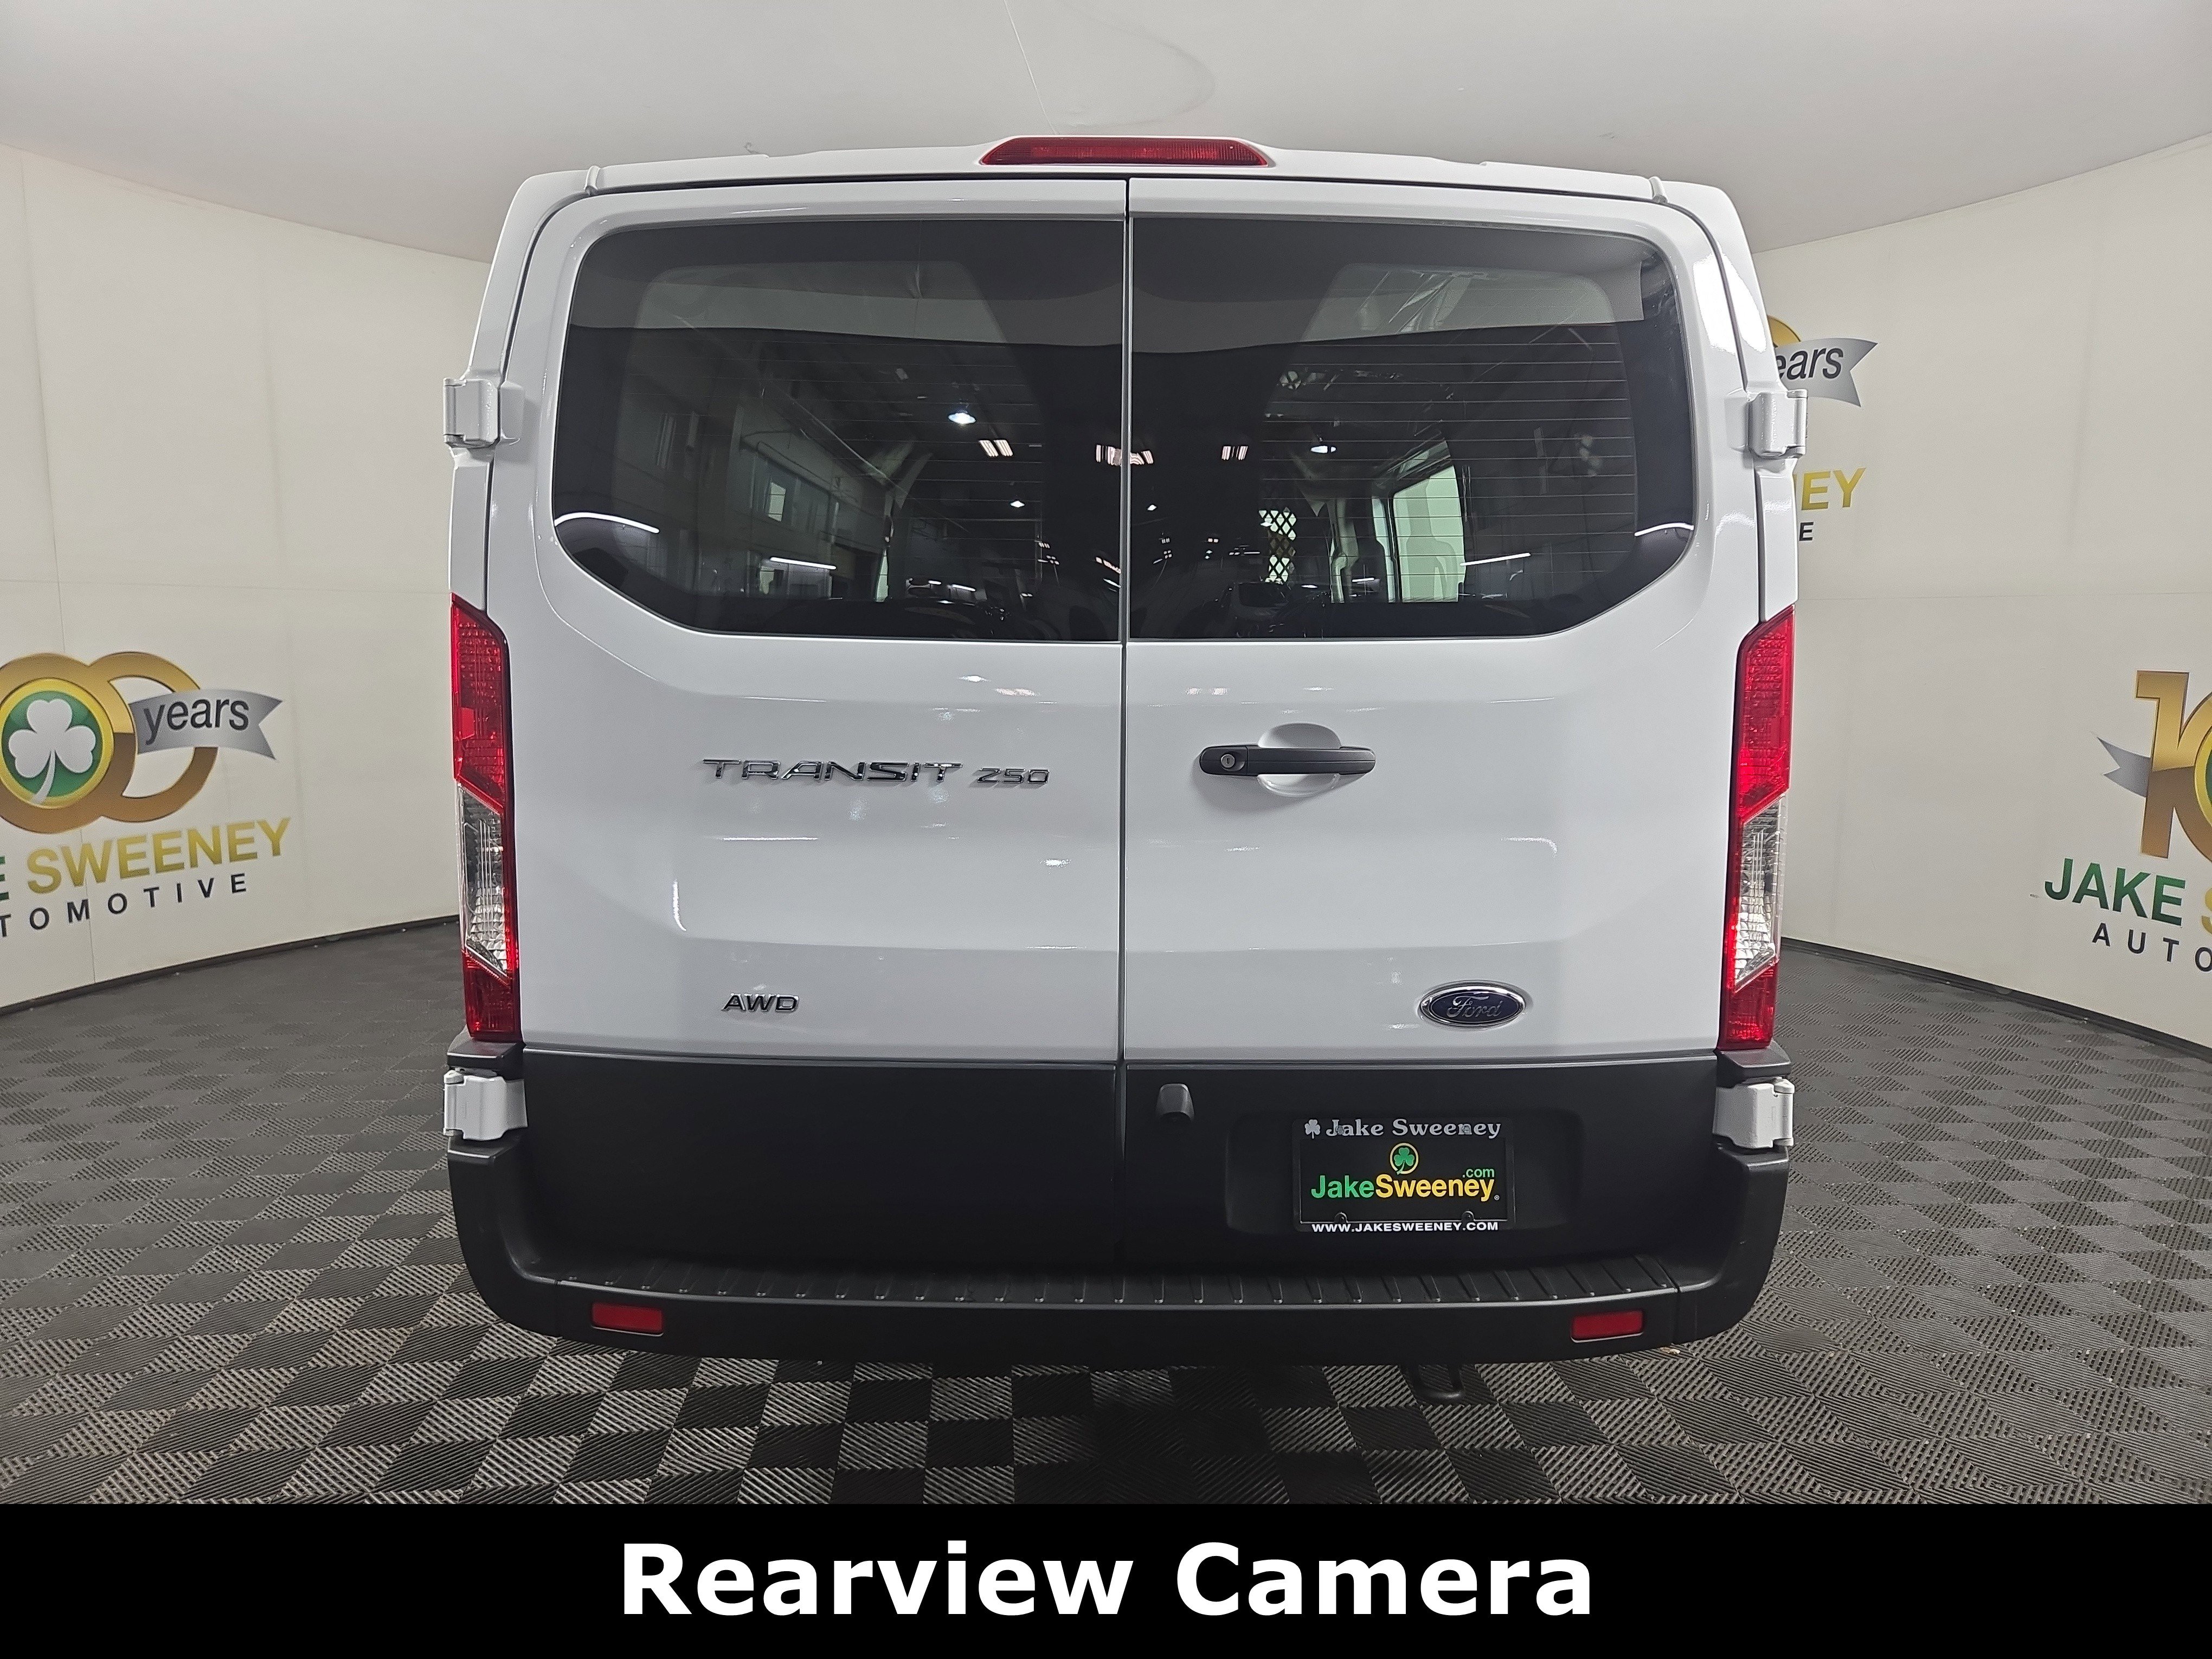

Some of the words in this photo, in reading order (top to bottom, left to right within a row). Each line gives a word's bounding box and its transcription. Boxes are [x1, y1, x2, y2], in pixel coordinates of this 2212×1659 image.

[1776, 348, 1843, 380] ears
[1793, 467, 1866, 511] EY
[143, 698, 250, 745] years
[703, 759, 963, 782] TRANSIT
[976, 767, 1050, 784] 250
[27, 818, 291, 895] SWEENEY
[2044, 857, 2186, 926] JAKE
[2092, 923, 2212, 972] AUTO
[721, 993, 799, 1012] AWD
[1446, 995, 1503, 1018] Ford
[1326, 1118, 1384, 1136] Jake
[1392, 1118, 1501, 1139] Sweeney
[1311, 1221, 1499, 1232] WWW.JAKESWEENEY.COM
